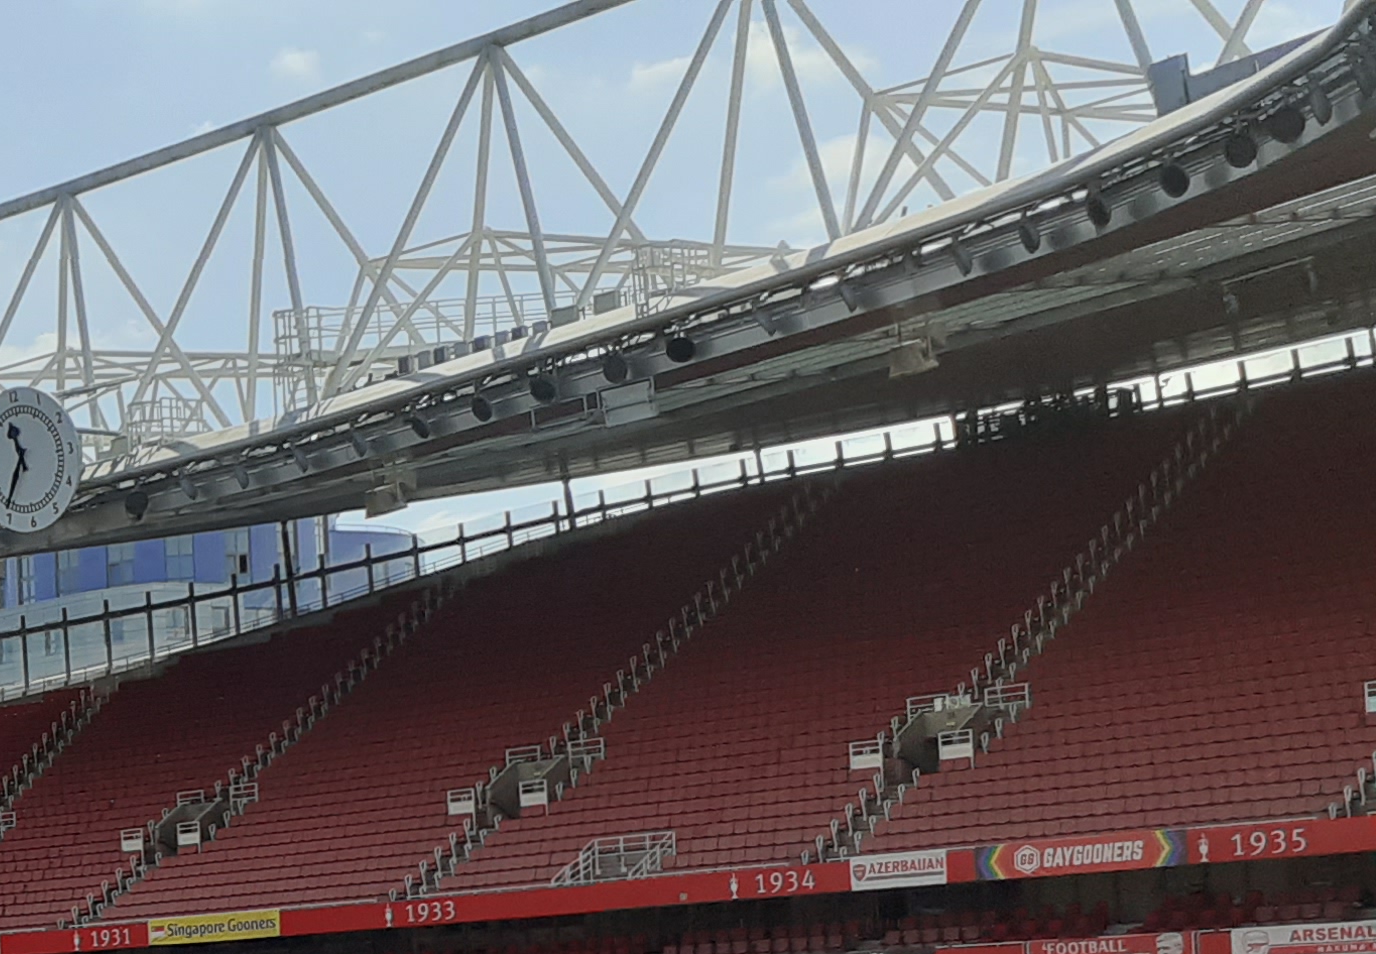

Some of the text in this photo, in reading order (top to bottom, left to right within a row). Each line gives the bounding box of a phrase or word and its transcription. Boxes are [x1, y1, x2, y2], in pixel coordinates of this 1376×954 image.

[8, 391, 19, 402] 12
[36, 393, 41, 405] 1
[55, 412, 63, 423] 2
[67, 442, 74, 454] 3
[66, 476, 73, 487] 4
[52, 502, 59, 514] 5
[6, 513, 11, 525] 7
[31, 516, 37, 528] 6
[1231, 829, 1307, 856] 1935
[1043, 841, 1144, 868] GAYGOONERS
[868, 857, 944, 873] AZERBAIJAN
[756, 870, 815, 893] 1934
[406, 901, 456, 922] 1933
[167, 915, 276, 938] Singapore Gooners
[91, 927, 131, 947] 1931
[1289, 925, 1376, 943] ARSENAL
